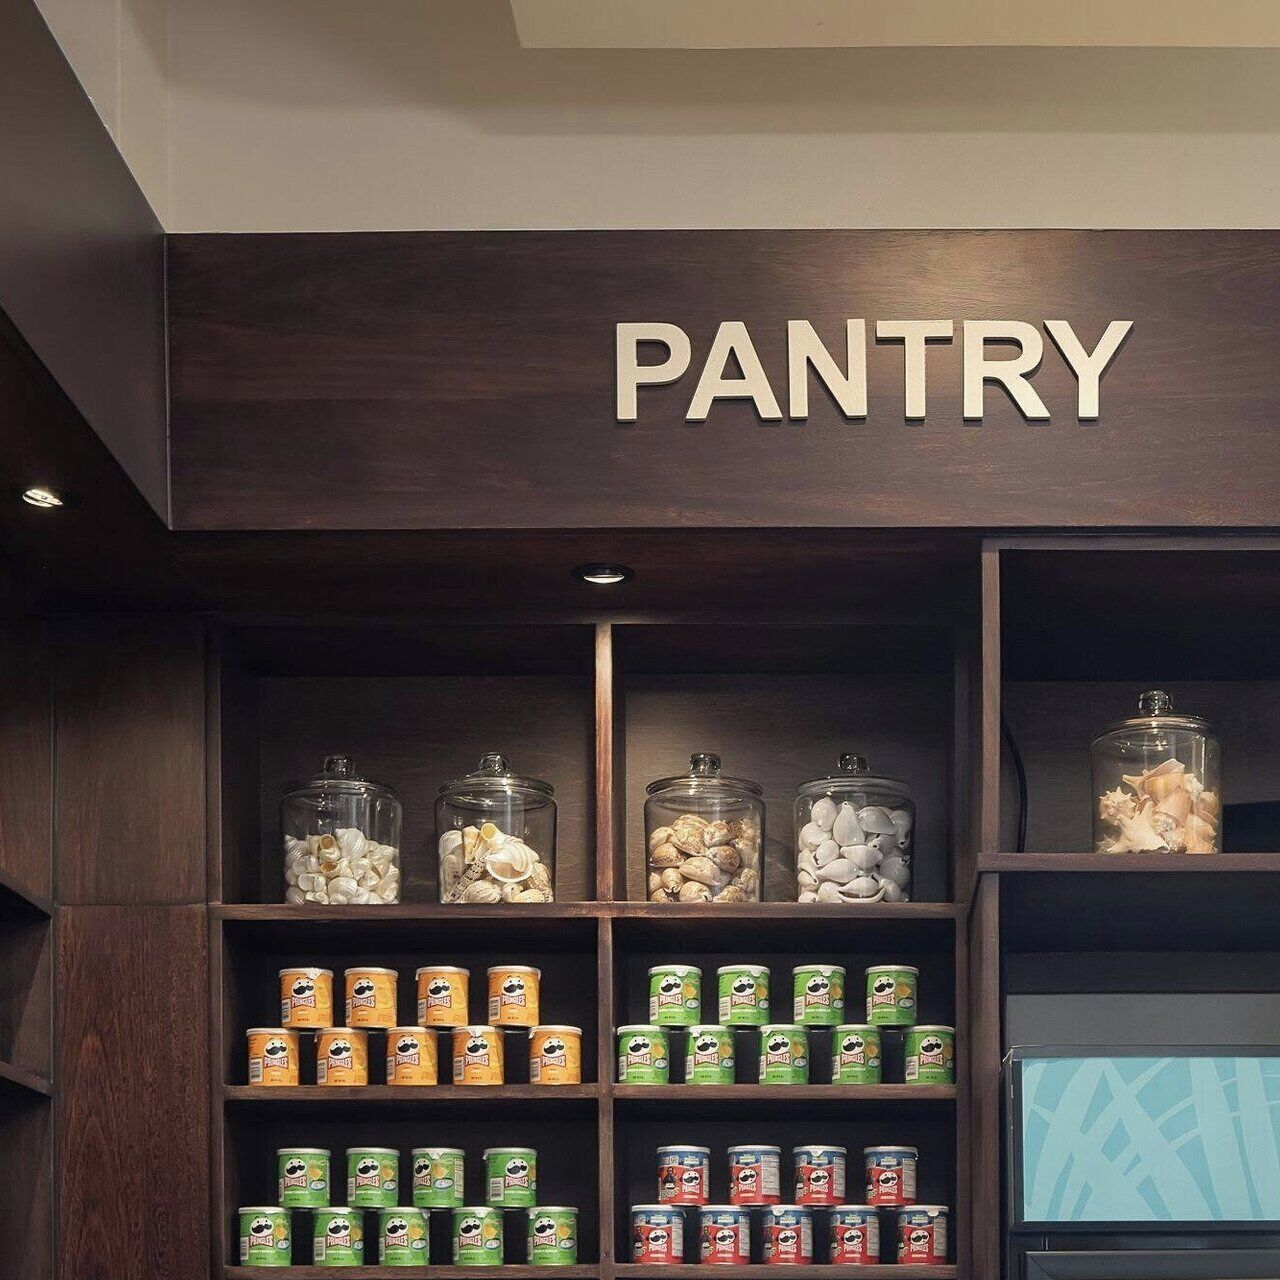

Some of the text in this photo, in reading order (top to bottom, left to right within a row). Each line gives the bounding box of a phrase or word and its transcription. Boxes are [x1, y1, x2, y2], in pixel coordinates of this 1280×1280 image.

[616, 318, 1135, 424] PANTRY
[659, 993, 683, 1007] PRINGLES
[731, 994, 756, 1007] PRINGLES
[805, 994, 830, 1007] PRINGLES
[627, 1053, 651, 1066] PRINGLES
[694, 1053, 719, 1066] PRINGLES
